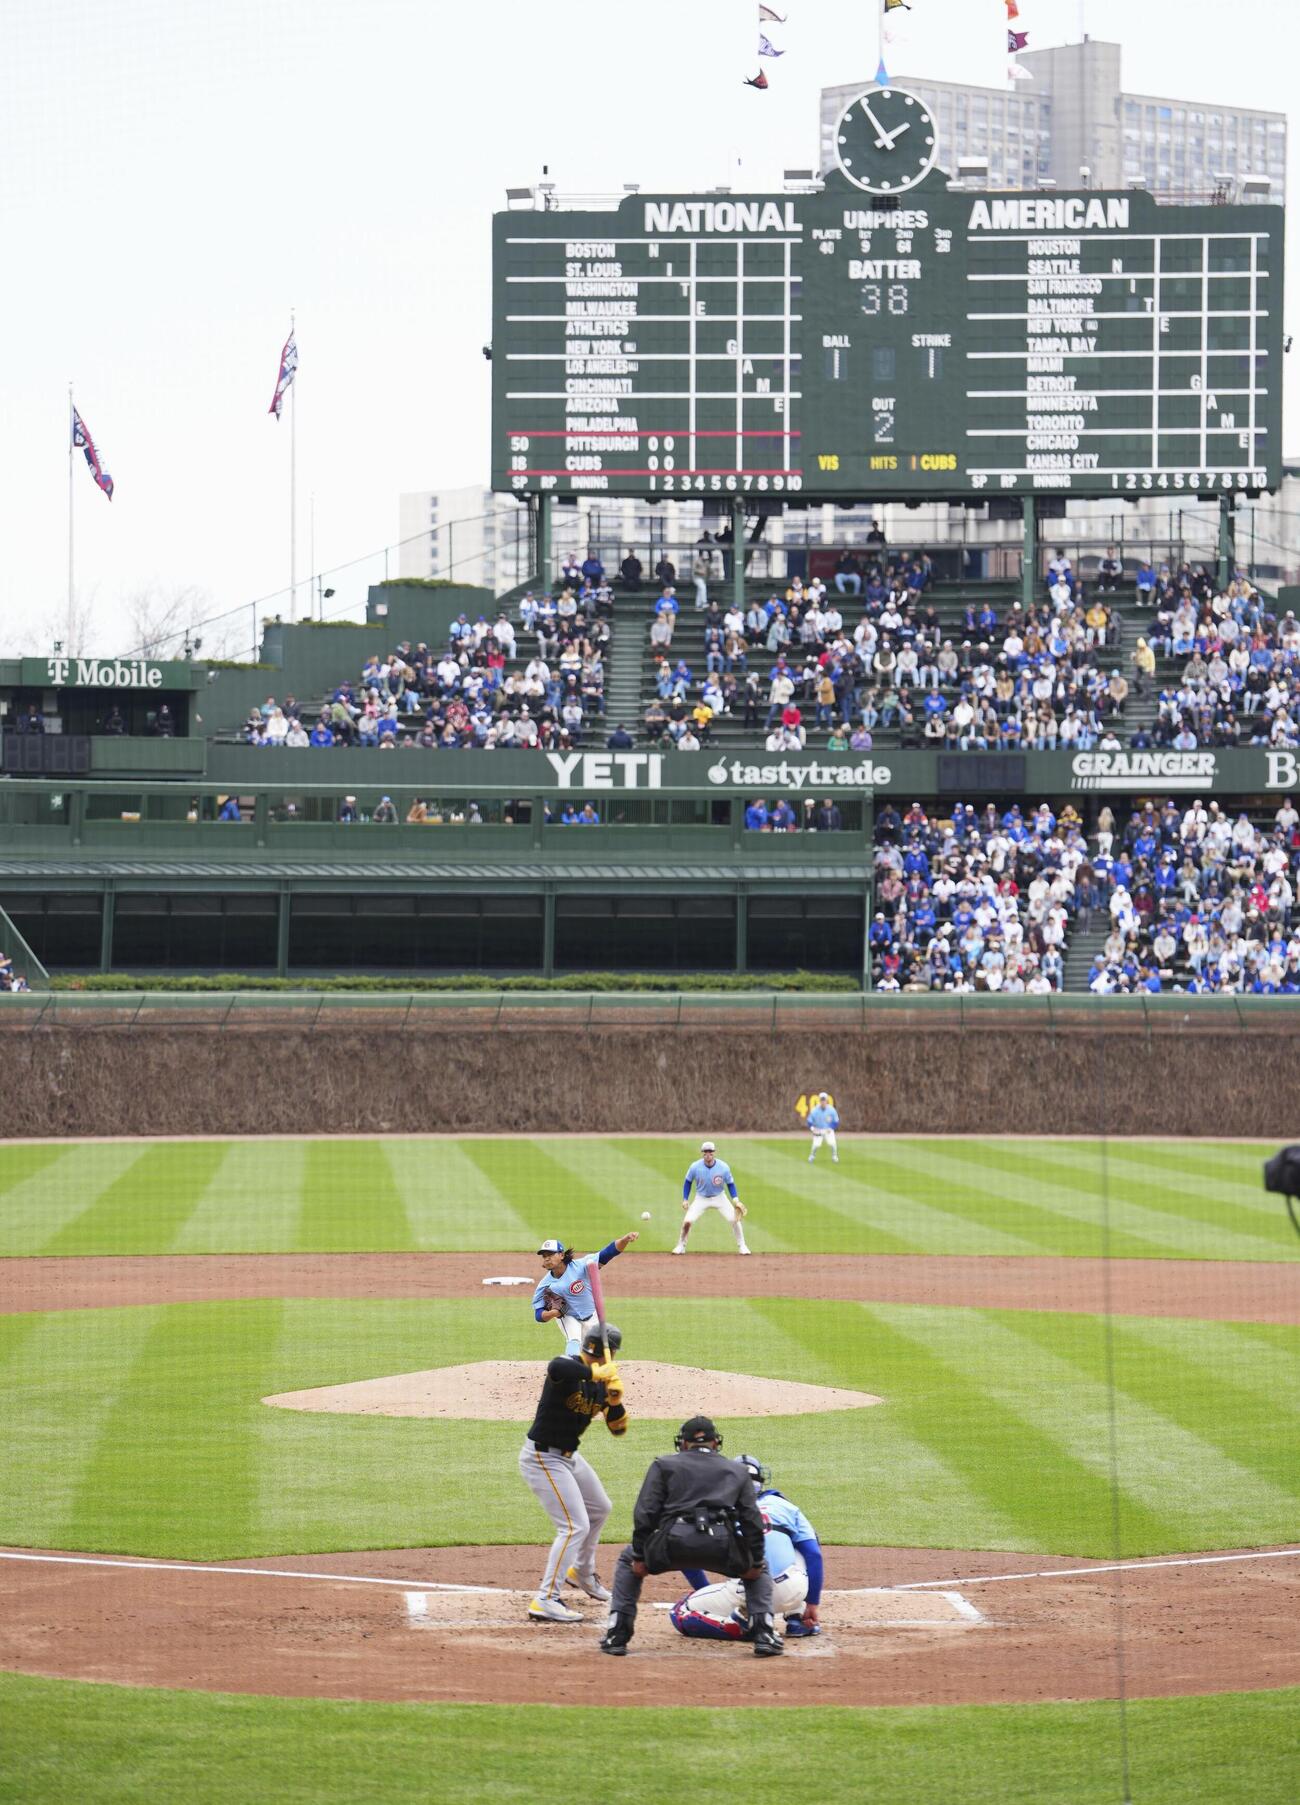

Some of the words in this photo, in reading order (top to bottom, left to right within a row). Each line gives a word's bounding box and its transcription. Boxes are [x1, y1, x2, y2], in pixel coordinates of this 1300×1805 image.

[645, 202, 803, 232] NATIONAL
[844, 210, 928, 230] UMPIRES
[968, 198, 1129, 229] AMERICAN
[812, 229, 842, 240] PLATE
[565, 244, 615, 258] BOSTON
[649, 244, 659, 258] N
[1028, 241, 1080, 255] HOUSTON
[566, 263, 585, 277] ST.
[586, 263, 622, 277] LOUIS
[666, 263, 672, 277] I
[848, 260, 921, 279] BATTER
[1028, 260, 1080, 274] SEATTLE
[1112, 260, 1123, 274] N
[565, 283, 638, 297] WASHINGTON
[680, 283, 690, 297] T
[1027, 280, 1046, 294] SAN
[1047, 280, 1102, 294] FRANCISCO
[1130, 279, 1136, 293] I
[861, 285, 908, 314] 38
[1027, 299, 1094, 313] BALTIMORE
[1144, 298, 1153, 312] T
[565, 302, 637, 316] MILWAUKEE
[697, 302, 706, 316] E
[565, 322, 629, 336] ATHLETICS
[1027, 319, 1051, 333] NEW
[1053, 319, 1083, 333] YORK
[1160, 318, 1169, 332] E
[566, 340, 591, 354] NEW
[591, 340, 622, 354] YORK
[726, 340, 738, 354] G
[823, 335, 851, 347] BALL
[912, 334, 951, 347] STRIKE
[1026, 338, 1070, 352] TAMPA
[1071, 338, 1097, 352] BAY
[565, 360, 585, 374] LOS
[586, 360, 628, 374] ANGELES
[743, 360, 753, 374] A
[1027, 358, 1063, 372] MIAMI
[565, 379, 632, 393] CINCINNATI
[756, 378, 770, 392] M
[1026, 376, 1077, 391] DETROIT
[1190, 375, 1201, 390] G
[565, 399, 619, 413] ARIZONA
[774, 399, 784, 412] E
[872, 398, 896, 411] OUT
[1026, 396, 1098, 411] MINNESOTA
[1207, 395, 1218, 410] A
[566, 417, 638, 432] PHILADELPHIA
[874, 412, 894, 442] 2
[1026, 415, 1085, 430] TORONTO
[1220, 414, 1235, 428] M
[511, 437, 529, 451] 50
[565, 437, 639, 451] PITTSBURGH
[648, 437, 658, 451] 0
[664, 437, 674, 451] 0
[1026, 435, 1079, 449] CHICAGO
[1239, 433, 1248, 448] E
[512, 456, 527, 470] 18
[565, 456, 602, 470] CUBS
[648, 456, 658, 470] 0
[664, 456, 674, 470] 0
[818, 455, 840, 470] VIS
[870, 455, 898, 470] HITS
[920, 455, 958, 470] CUBS
[1026, 454, 1073, 468] KANSAS
[1073, 454, 1100, 468] CITY
[512, 476, 528, 489] SP
[540, 476, 557, 489] RP
[571, 476, 608, 489] INNING
[650, 476, 656, 490] 1
[663, 476, 674, 490] 2
[681, 476, 691, 490] 3
[694, 476, 705, 490] 4
[711, 476, 721, 490] 5
[726, 476, 737, 490] 6
[743, 476, 752, 490] 7
[757, 476, 768, 490] 8
[773, 476, 784, 490] 9
[787, 476, 802, 490] 10
[971, 474, 988, 488] SP
[1000, 474, 1017, 488] RP
[1033, 474, 1071, 488] INNING
[1112, 474, 1118, 488] 1
[1126, 474, 1136, 488] 2
[1142, 474, 1152, 488] 3
[1157, 474, 1168, 488] 4
[1174, 474, 1184, 488] 5
[1189, 474, 1200, 488] 6
[1206, 474, 1216, 488] 7
[1221, 474, 1232, 488] 8
[1238, 474, 1248, 488] 9
[1252, 474, 1267, 488] 10
[48, 658, 69, 684] T
[75, 660, 163, 687] Mobile
[546, 753, 661, 788] YETI
[1072, 752, 1216, 776] GRAINGER
[730, 760, 891, 790] tastytrade
